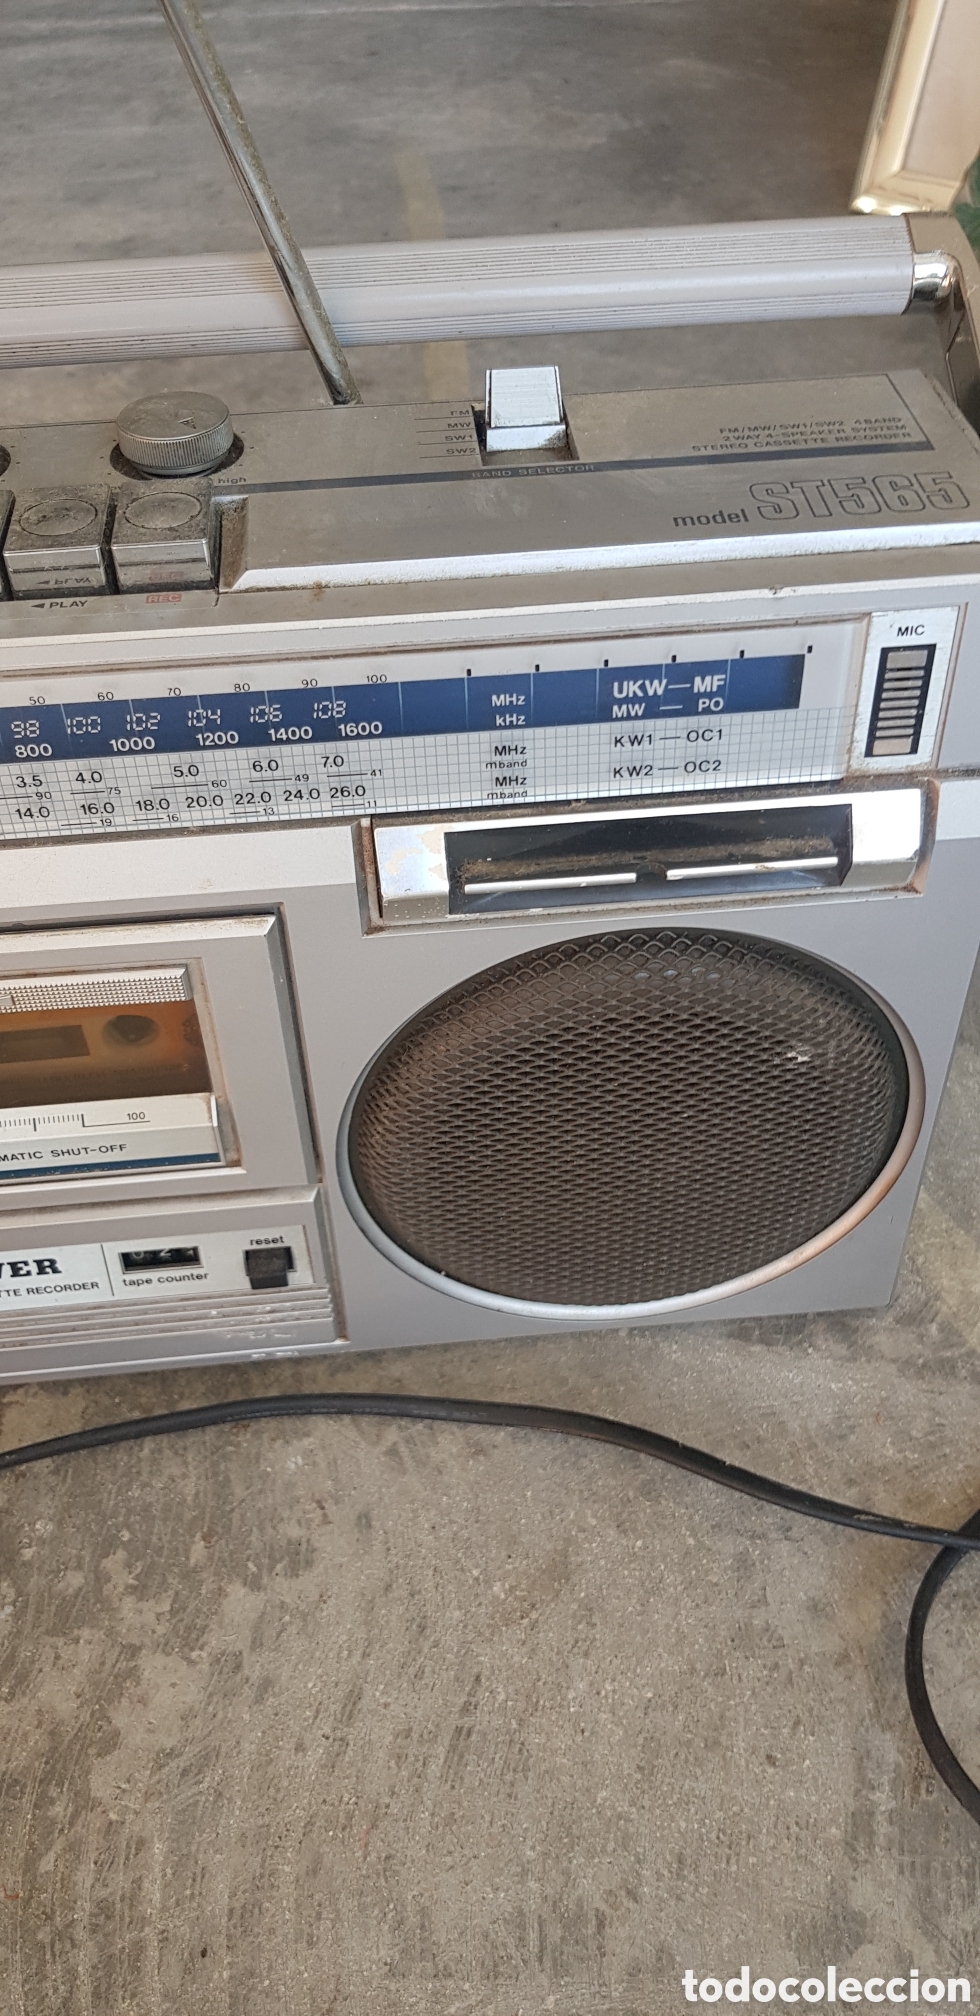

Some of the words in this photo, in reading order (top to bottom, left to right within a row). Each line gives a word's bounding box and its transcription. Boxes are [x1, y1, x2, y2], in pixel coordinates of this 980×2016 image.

[765, 428, 847, 439] 4-SPEAKER
[851, 424, 907, 433] SYSTEM
[691, 443, 748, 452] STEREO
[754, 437, 831, 448] CASSETTE
[835, 432, 912, 443] RECORDER
[446, 447, 477, 455] SW2
[472, 471, 512, 479] BAND
[518, 464, 595, 476] SELECTOR
[218, 476, 247, 486] high
[673, 509, 749, 527] model
[749, 472, 970, 521] ST565
[49, 600, 88, 609] PLAY
[148, 594, 180, 603] REC
[897, 624, 925, 637] MIC
[29, 695, 46, 706] 50
[97, 691, 115, 702] 60
[167, 687, 182, 697] 70
[234, 683, 251, 692] 80
[301, 679, 318, 688] 90
[366, 674, 388, 684] 100
[11, 720, 40, 738] 98
[66, 716, 101, 734] 100
[126, 712, 161, 731] 102
[187, 709, 222, 727] 104
[250, 704, 283, 723] 106
[313, 700, 347, 719] 108
[491, 693, 526, 707] MHz
[612, 703, 646, 718] MW
[698, 698, 724, 712] PO
[14, 743, 53, 758] 800
[109, 736, 156, 753] 1000
[195, 731, 239, 747] 1200
[268, 726, 313, 742] 1400
[337, 721, 383, 737] 1600
[495, 713, 526, 727] kHz
[614, 733, 653, 748] KW1
[686, 729, 724, 742] OC1
[15, 774, 43, 788] 3.5
[75, 771, 103, 784] 4.0
[173, 764, 200, 778] 5.0
[252, 759, 279, 773] 6.0
[320, 755, 345, 769] 7.0
[494, 744, 527, 757] MHz
[613, 763, 653, 778] KW2
[684, 759, 722, 773] OC2
[35, 791, 52, 801] 90
[107, 786, 122, 796] 75
[211, 779, 227, 788] 60
[294, 773, 310, 783] 49
[370, 769, 383, 777] 41
[485, 758, 528, 769] mband
[15, 806, 50, 819] 14.0
[80, 802, 115, 815] 16.0
[136, 798, 170, 812] 18.0
[186, 794, 224, 809] 20.0
[235, 791, 272, 804] 22.0
[283, 787, 321, 801] 24.0
[329, 784, 366, 799] 26.0
[495, 775, 528, 787] MHz
[101, 818, 112, 827] 19
[167, 813, 180, 823] 16
[263, 807, 275, 817] 13
[366, 799, 378, 808] 11
[487, 789, 528, 799] mband
[127, 1112, 146, 1121] 100
[50, 1144, 127, 1157] SHUT-OFF
[249, 1235, 285, 1246] reset
[27, 1281, 100, 1295] RECORDER
[123, 1278, 153, 1287] tape
[158, 1272, 209, 1284] counter
